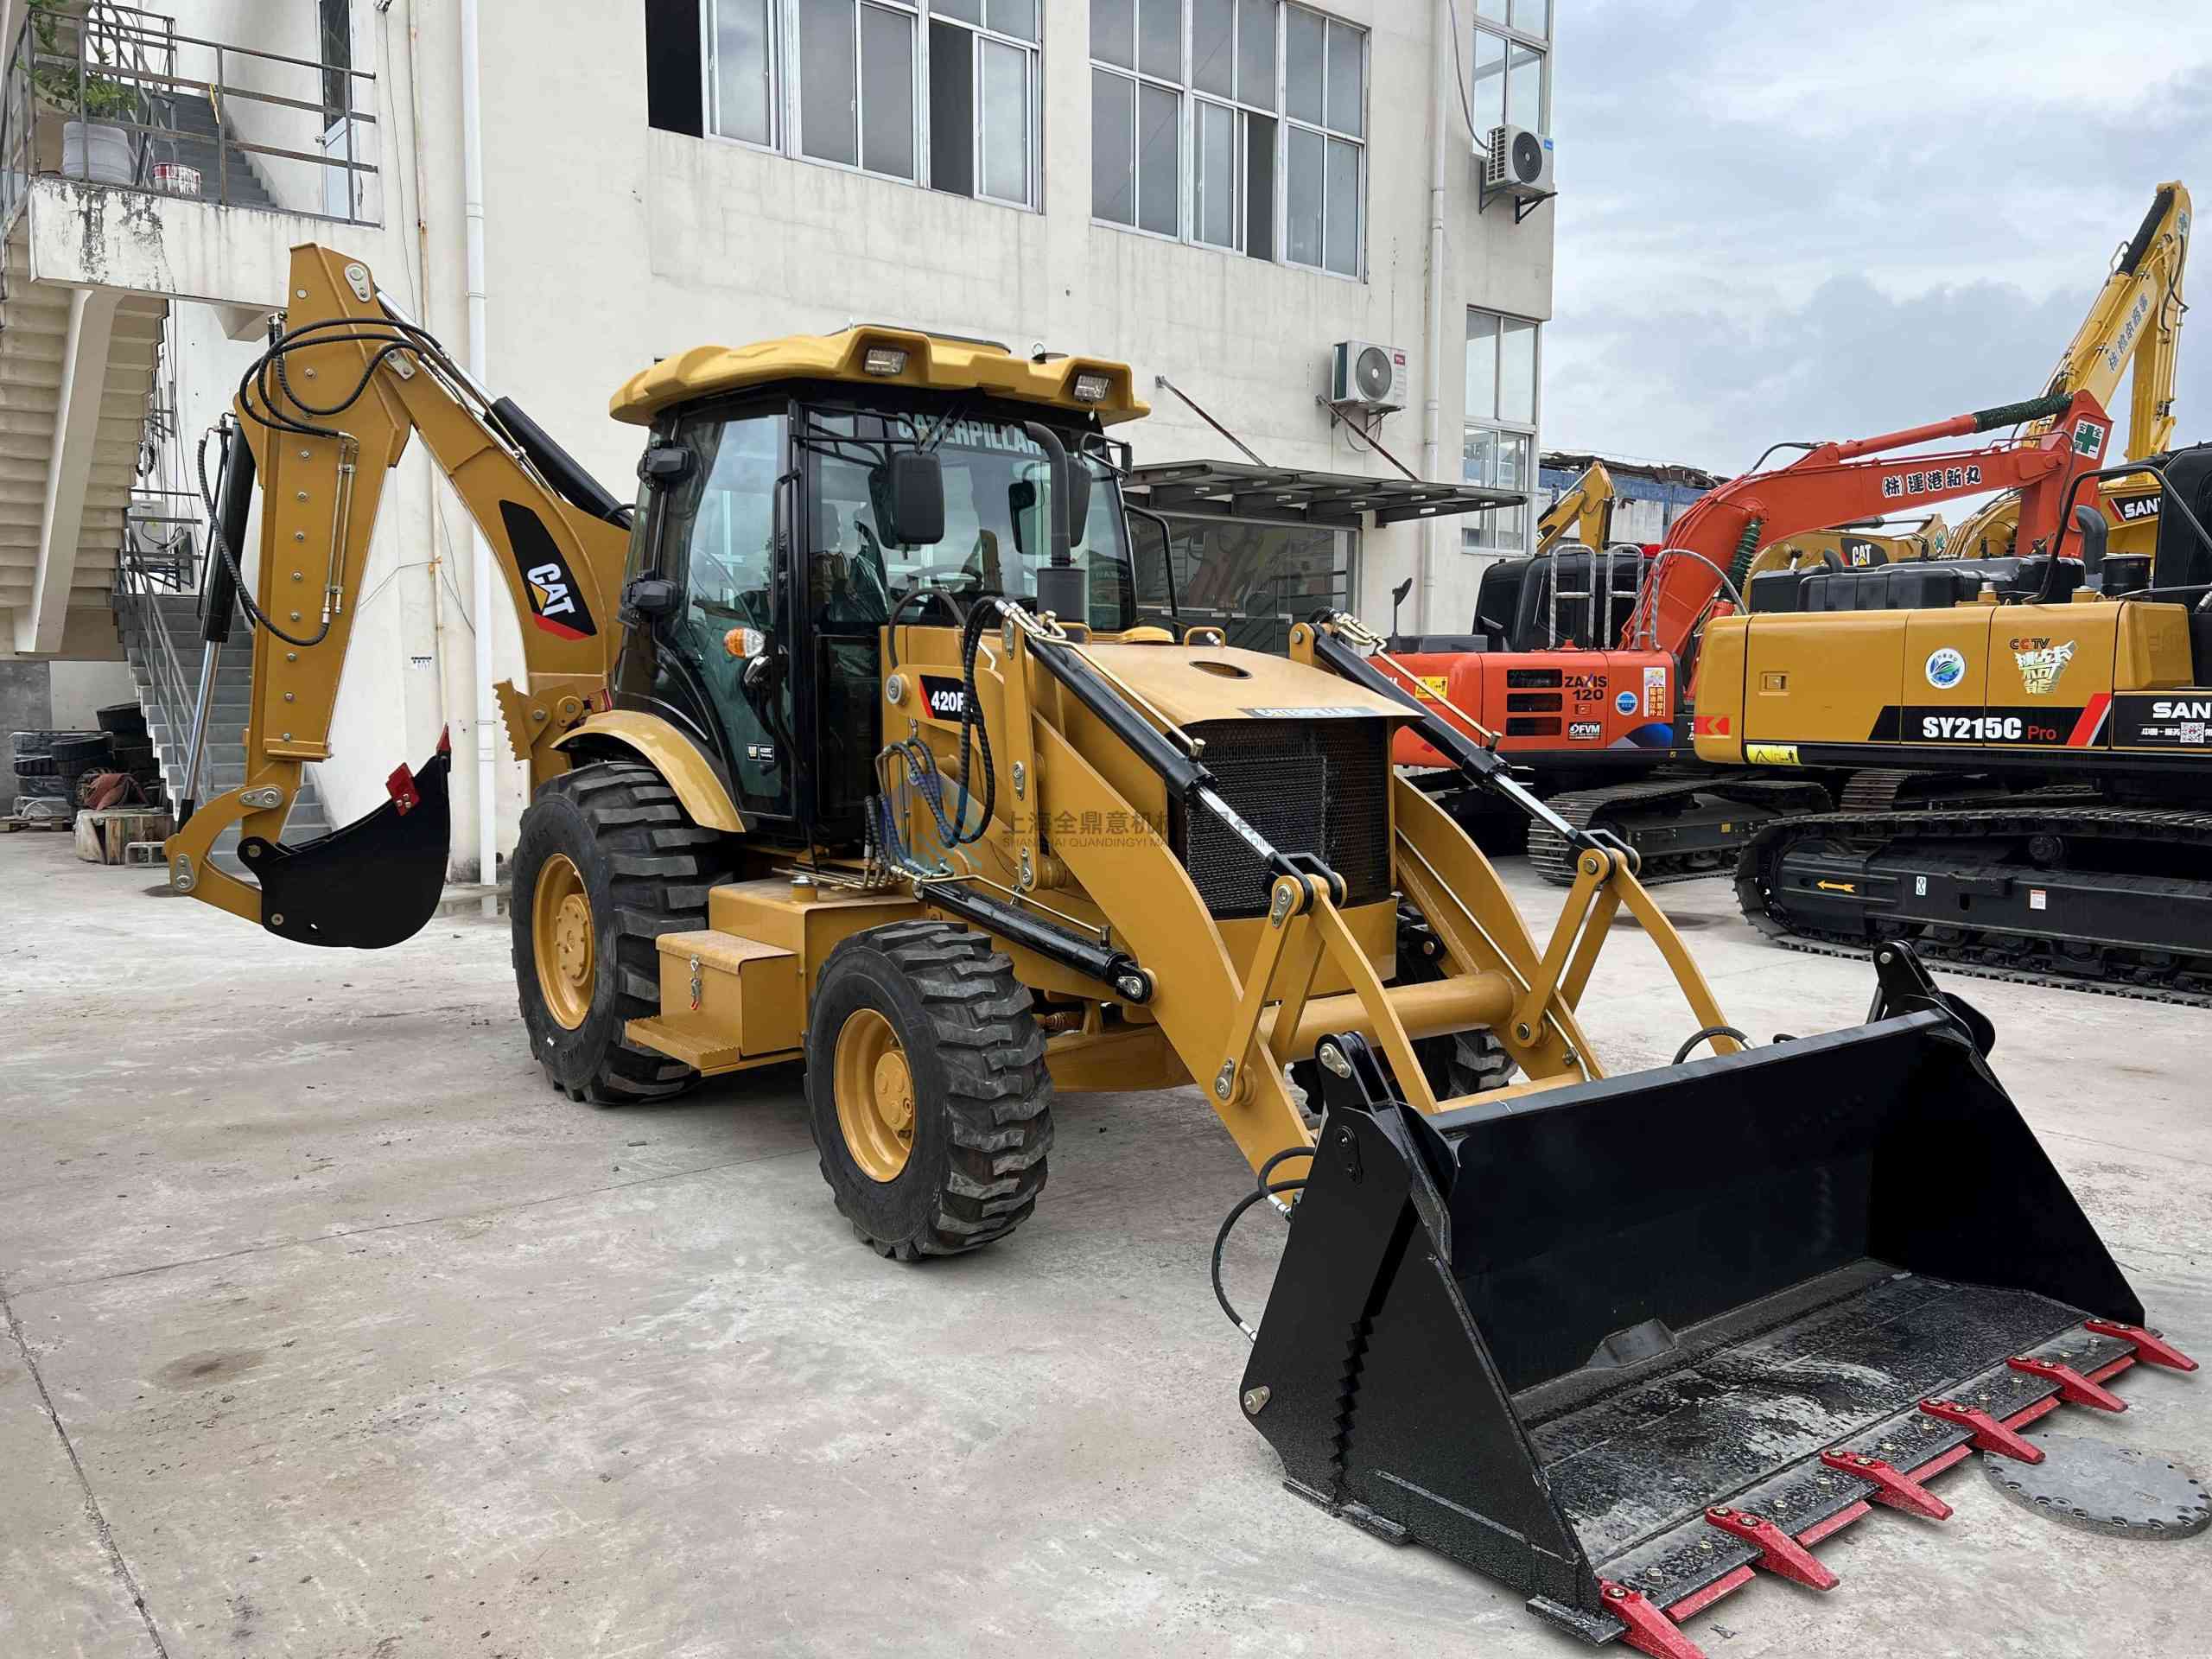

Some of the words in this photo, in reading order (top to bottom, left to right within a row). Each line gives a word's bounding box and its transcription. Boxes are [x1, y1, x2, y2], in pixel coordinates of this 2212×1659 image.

[2124, 497, 2161, 518] SAN
[1852, 544, 1872, 567] CAT
[527, 563, 575, 616] CAT
[2010, 638, 2050, 650] CCTV
[1565, 673, 1607, 688] ZAXIS
[931, 691, 973, 712] 420F
[1573, 689, 1604, 701] 120
[2152, 702, 2212, 719] SAN
[1923, 716, 2022, 740] SY215C
[2027, 725, 2056, 741] Pro
